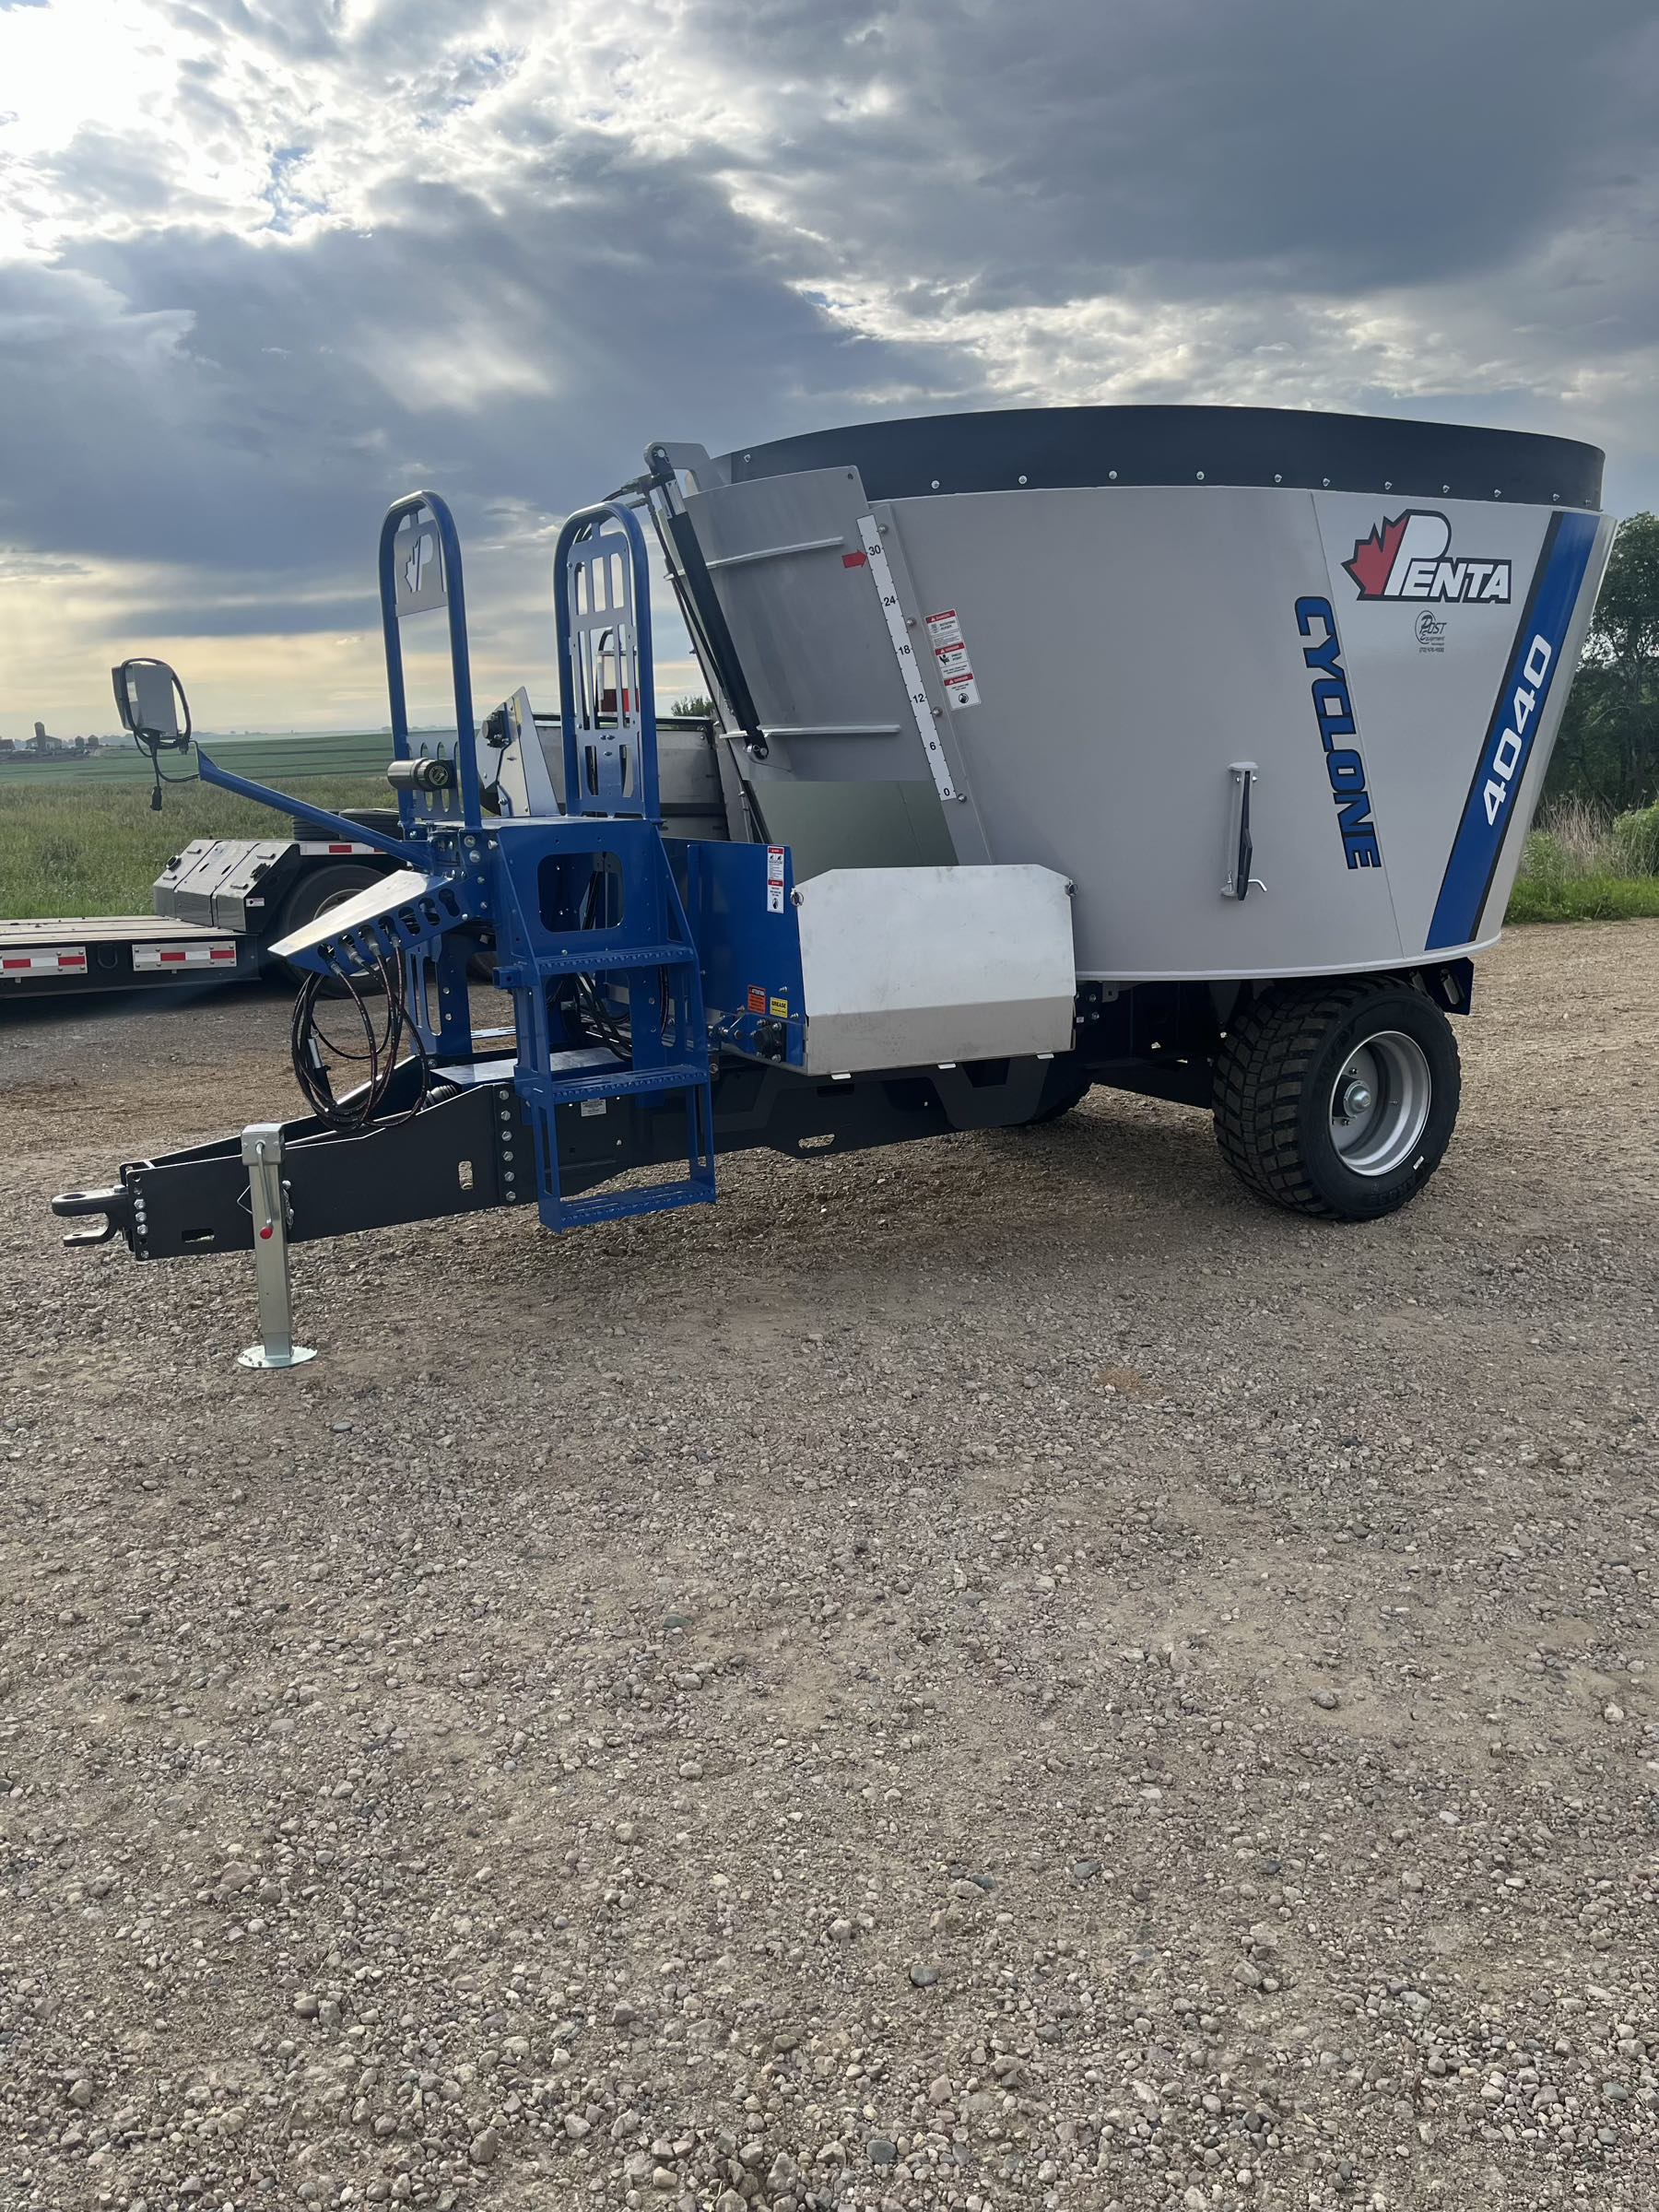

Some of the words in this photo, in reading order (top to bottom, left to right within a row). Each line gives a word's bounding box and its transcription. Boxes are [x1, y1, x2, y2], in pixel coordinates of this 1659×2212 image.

[868, 545, 882, 556] 30
[1382, 510, 1512, 604] PENTA
[884, 596, 896, 606] 24
[899, 645, 911, 655] 18
[912, 693, 925, 704] 12
[1294, 595, 1382, 869] CYCLONE
[1484, 634, 1551, 826] 4040
[929, 741, 936, 751] 6
[943, 787, 950, 797] 0
